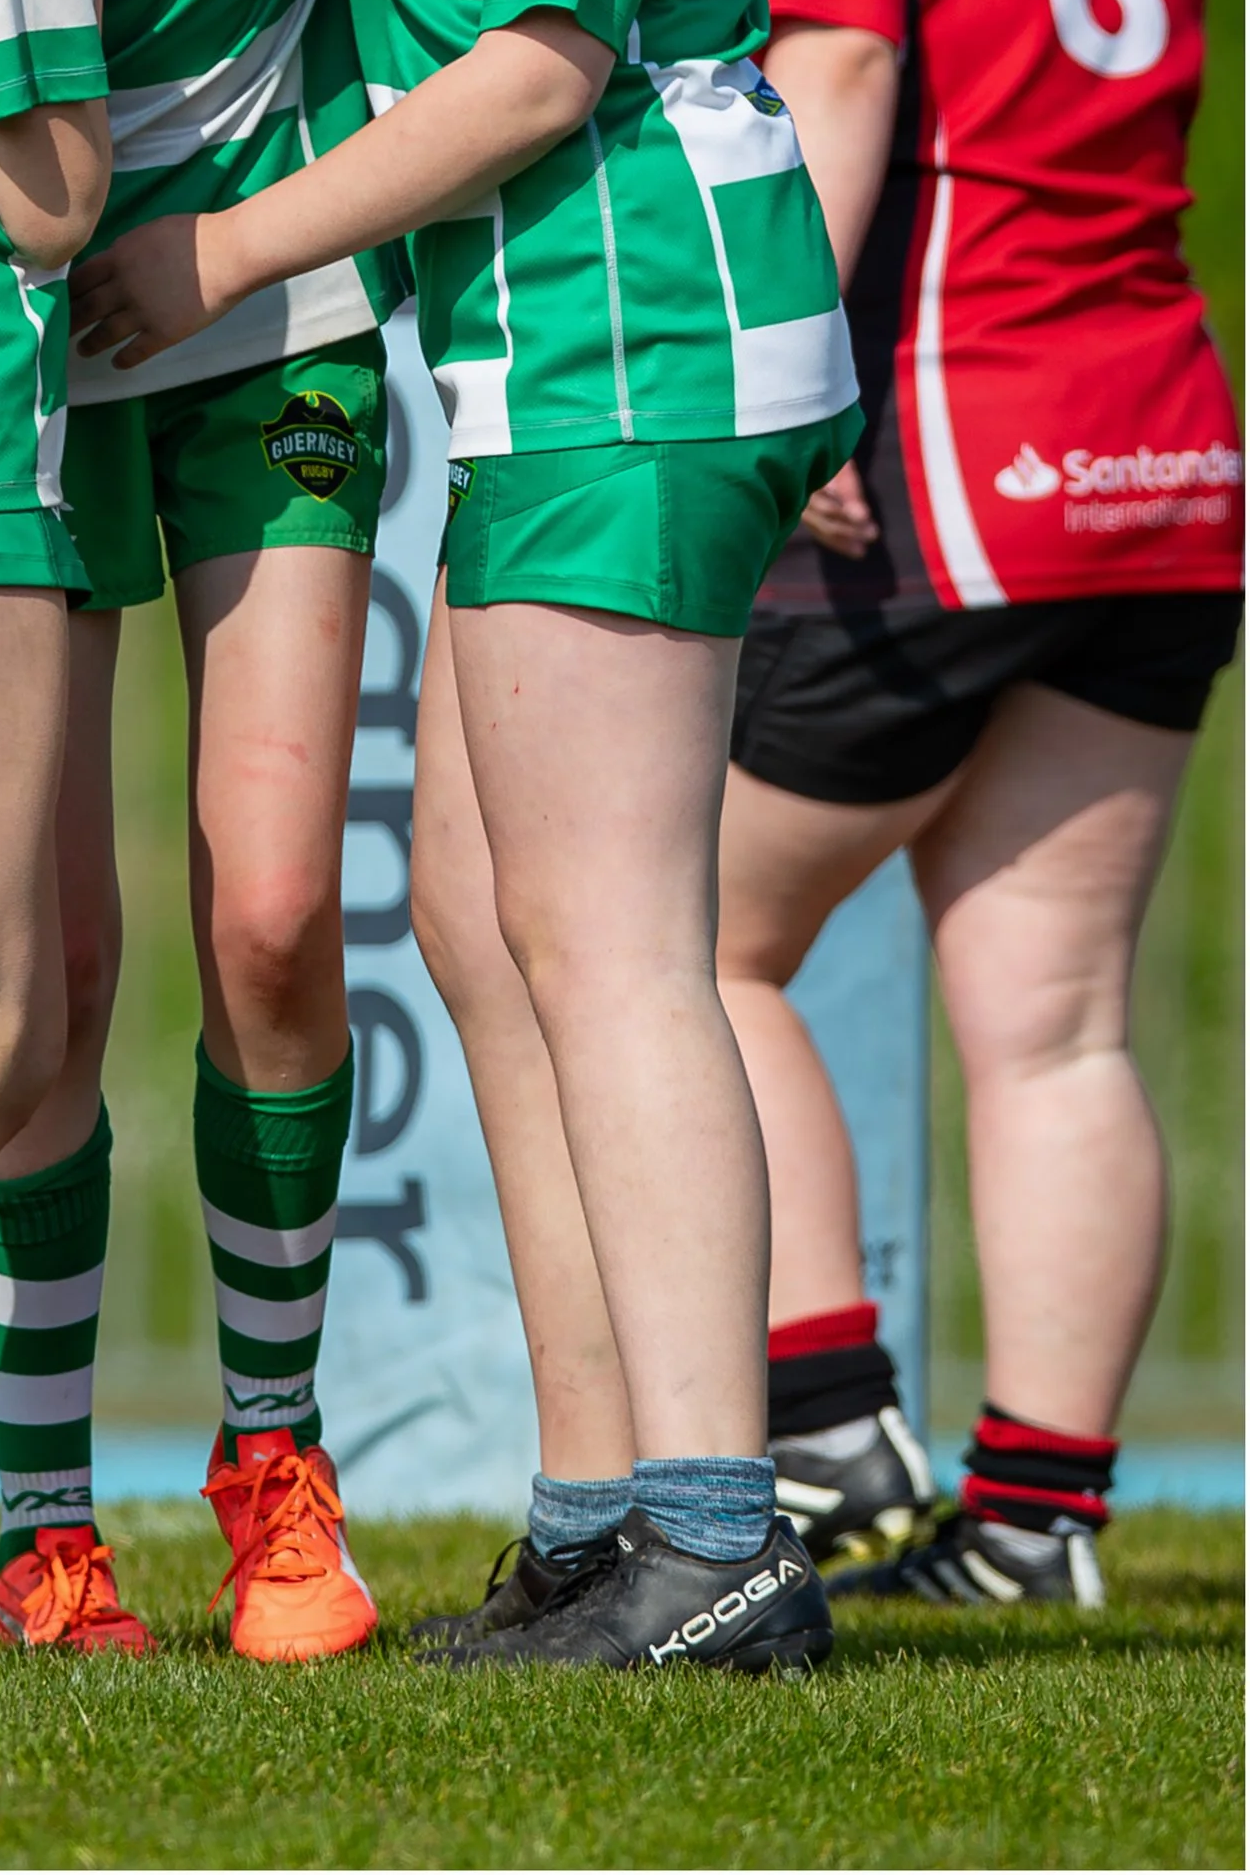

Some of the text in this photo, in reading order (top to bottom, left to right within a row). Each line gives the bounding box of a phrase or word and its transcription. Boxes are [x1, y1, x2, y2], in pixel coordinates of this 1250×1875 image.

[271, 431, 356, 463] GUERNSEY
[301, 464, 335, 481] RUGBY
[649, 1558, 805, 1666] KOOGA
